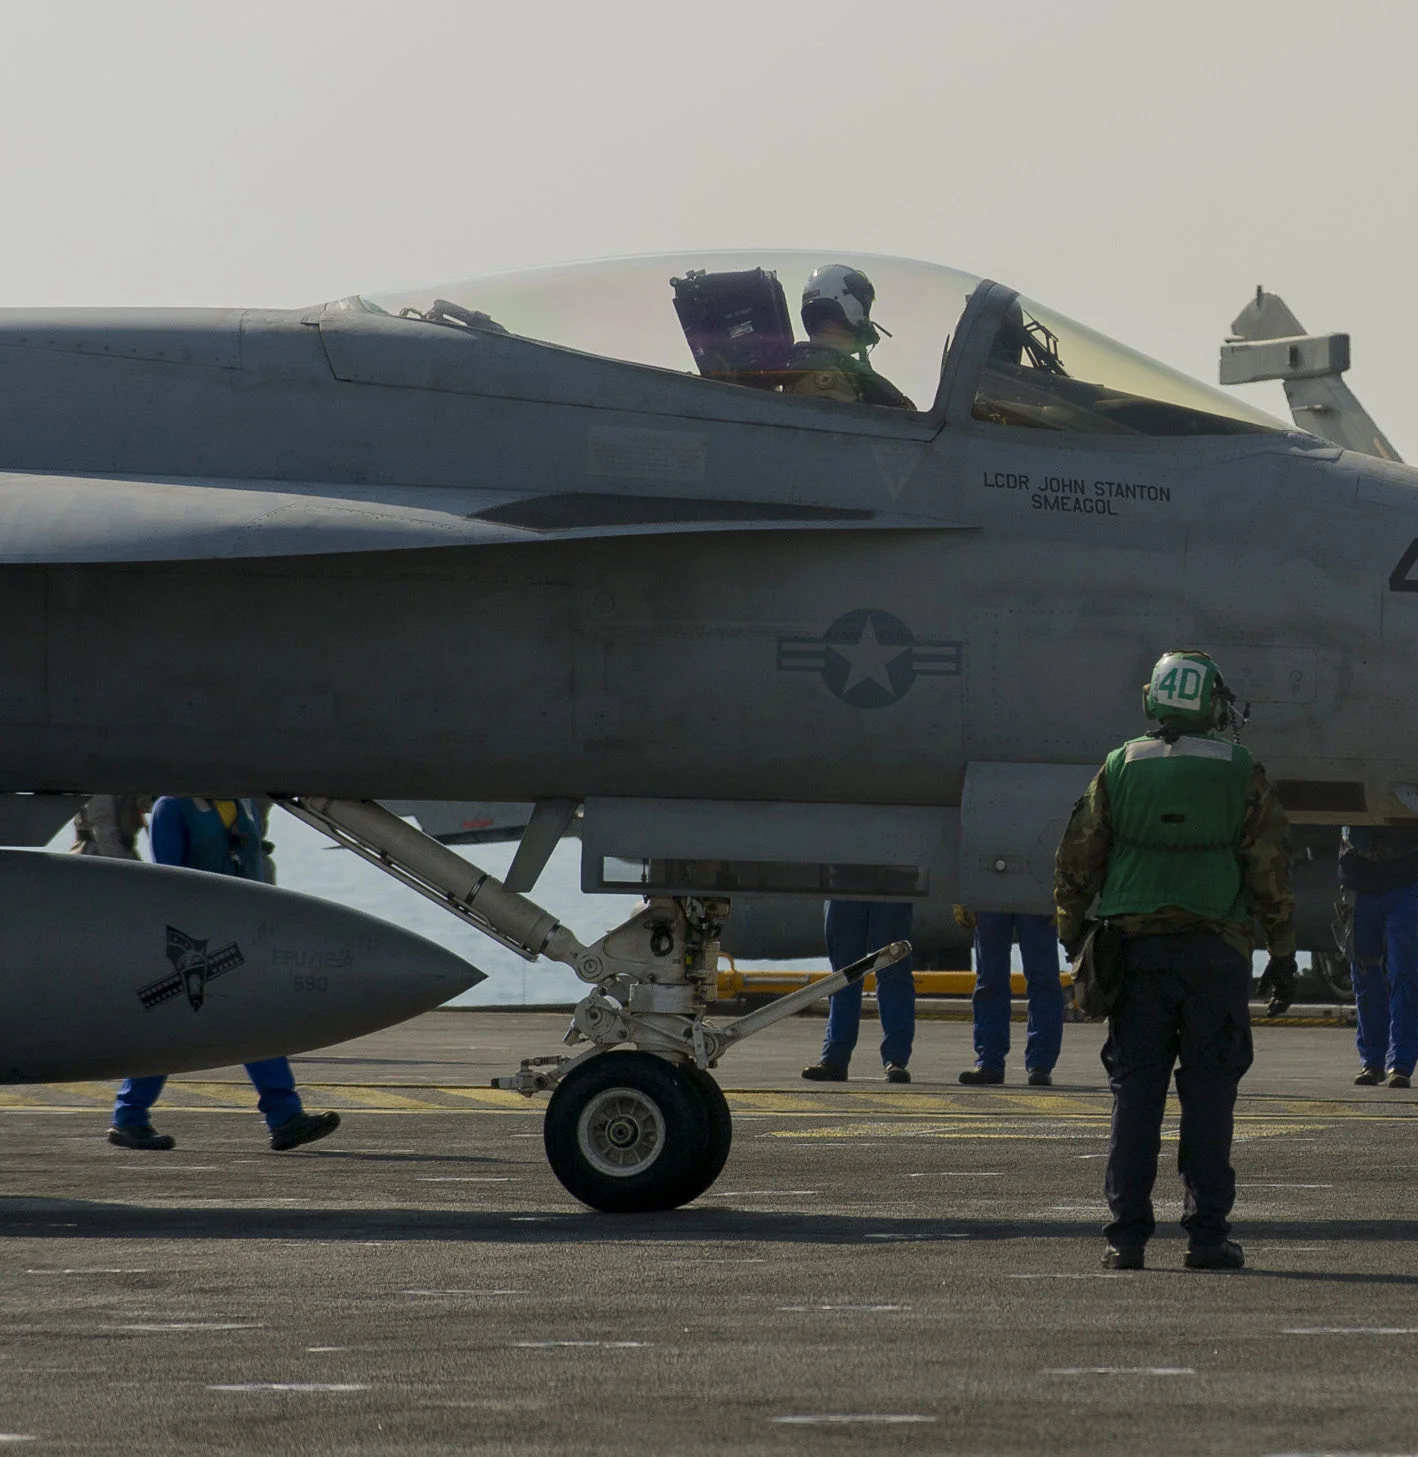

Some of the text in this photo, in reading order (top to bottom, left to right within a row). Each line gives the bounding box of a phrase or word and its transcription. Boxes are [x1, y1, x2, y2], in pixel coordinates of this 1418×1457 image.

[983, 472, 1171, 503] LCDR JOHN STANTON
[1031, 494, 1119, 516] SMEAGOL
[1158, 667, 1201, 701] 4D
[293, 975, 328, 992] 590
